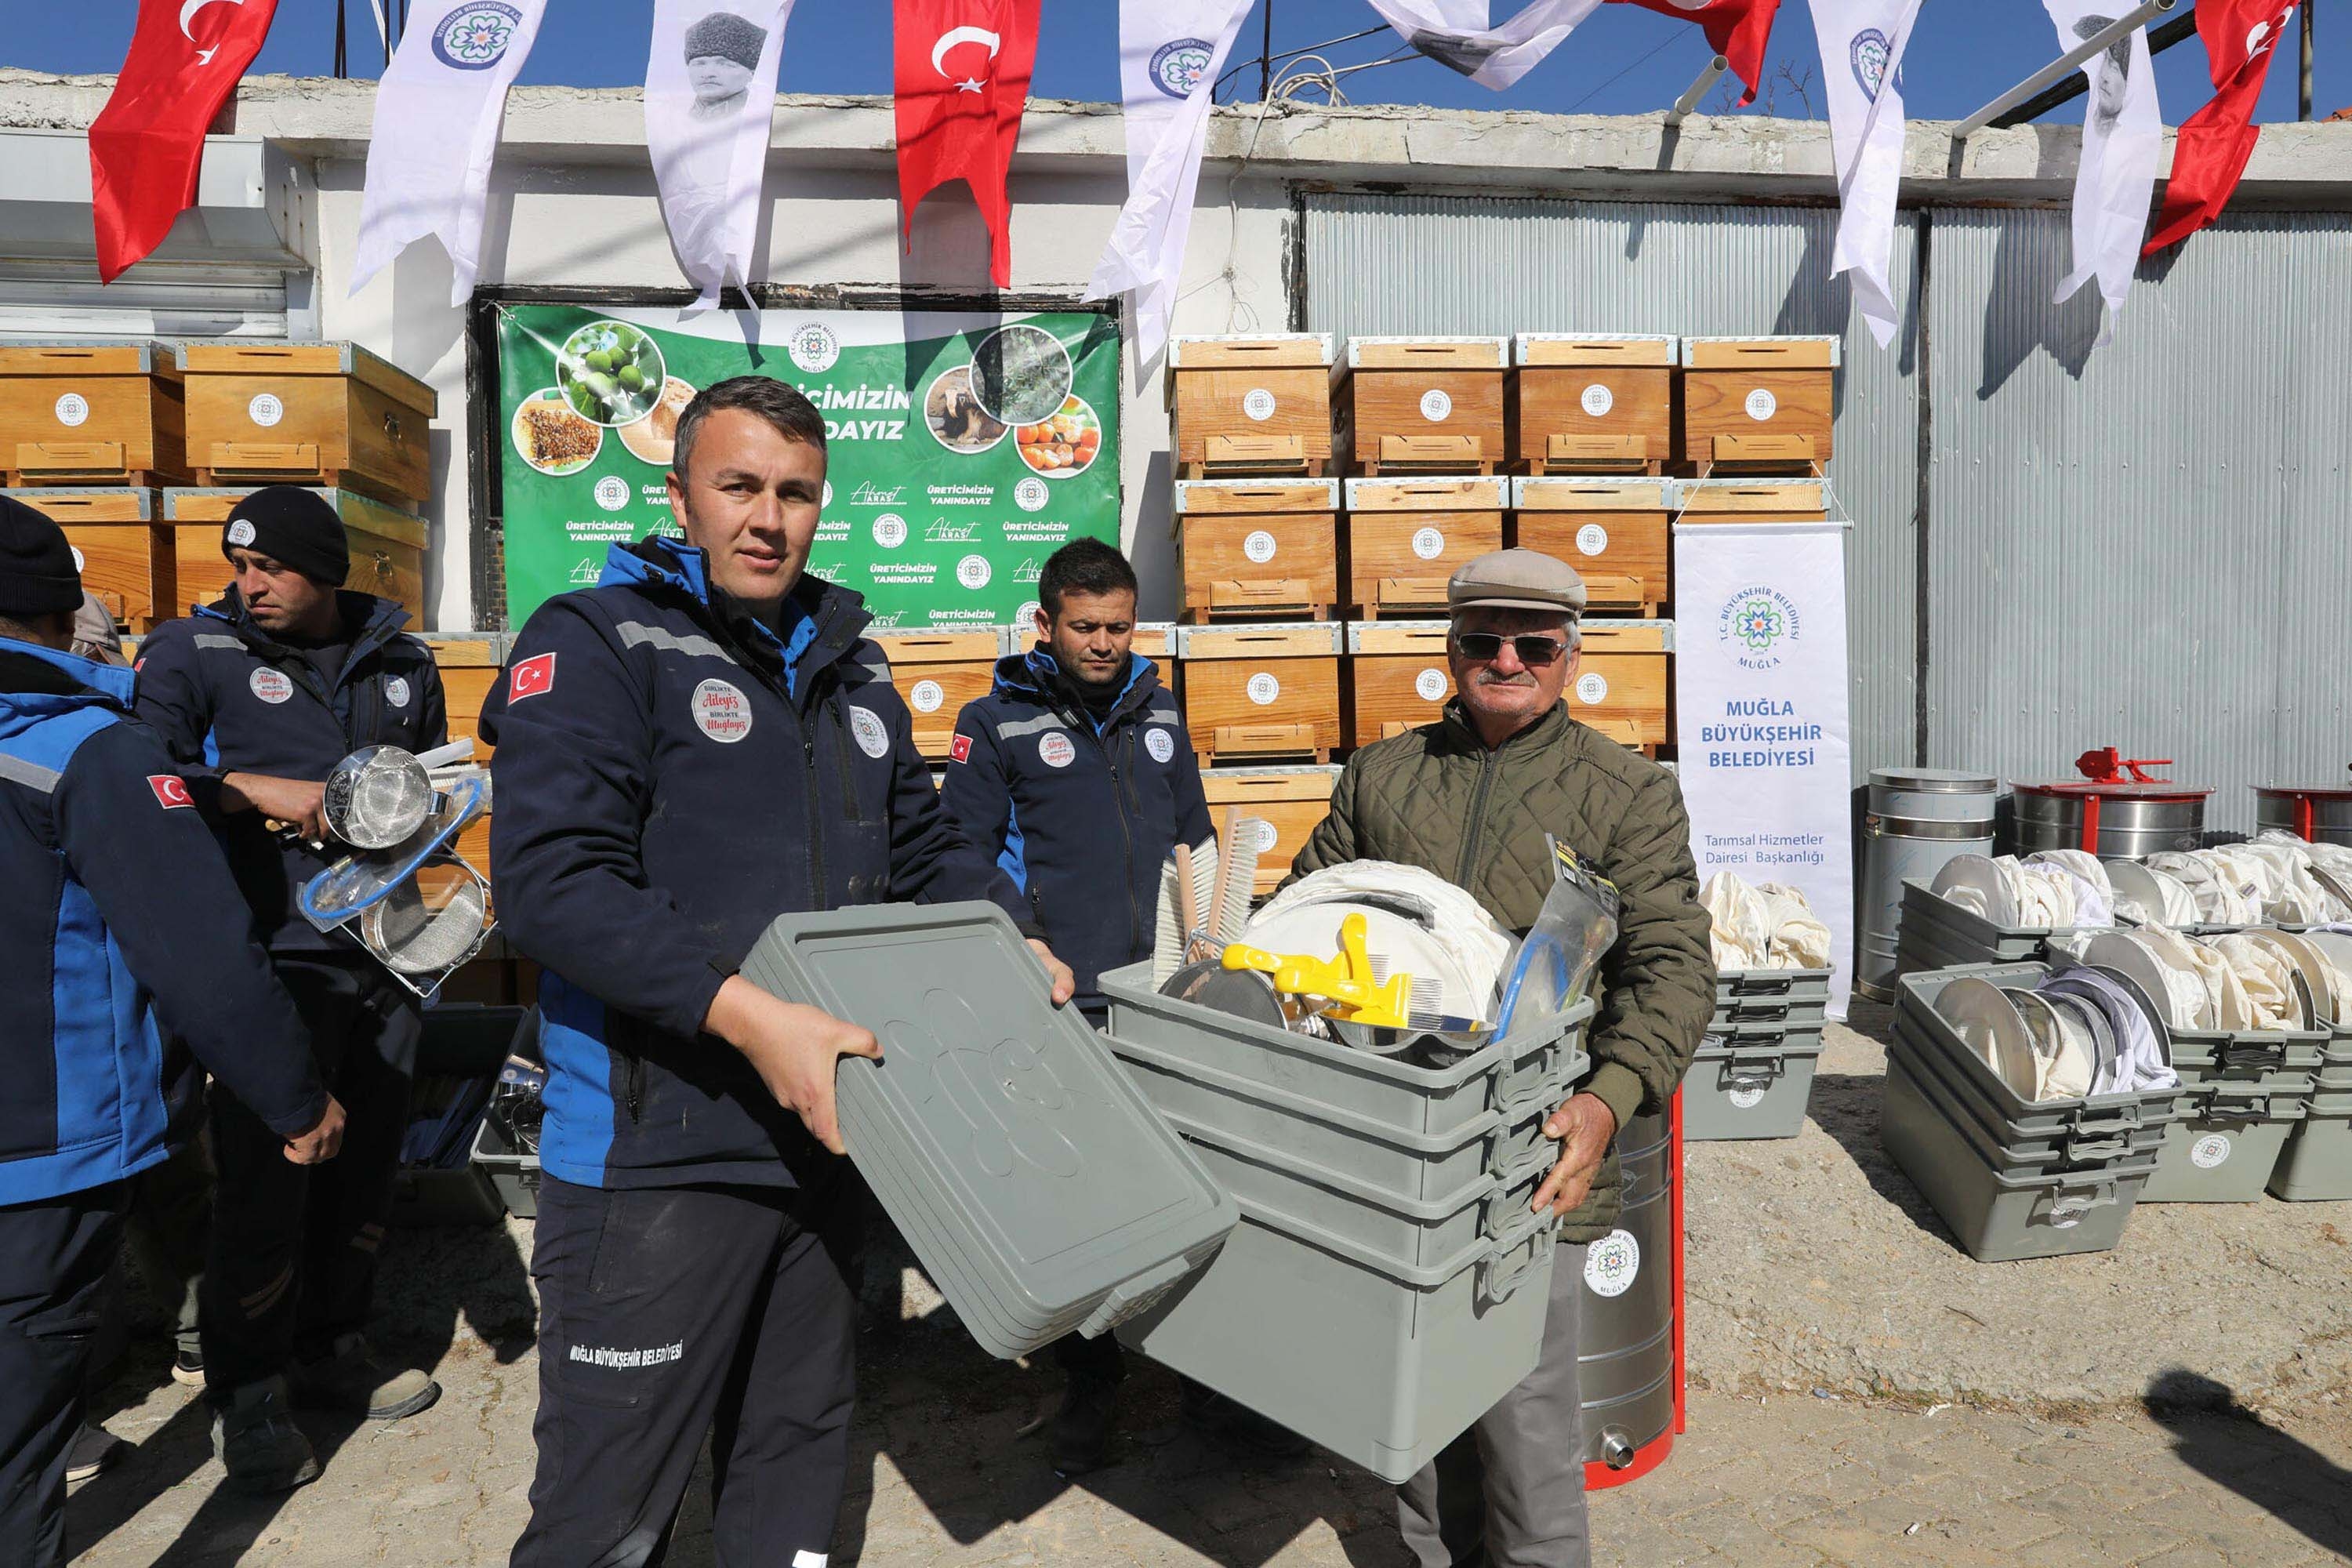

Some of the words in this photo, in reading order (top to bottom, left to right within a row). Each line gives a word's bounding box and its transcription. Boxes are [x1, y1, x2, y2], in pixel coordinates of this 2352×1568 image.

[797, 383, 910, 409] CİMİZİN
[826, 420, 905, 440] DAYIZ
[927, 484, 994, 495] ÜRETİCİMİZİN
[565, 520, 634, 531] ÜRETİCİMİZİN
[1003, 521, 1069, 531] ÜRETİCİMİZİN
[869, 562, 937, 573] ÜRETİCİMİZİN
[873, 575, 935, 584] YANINDAYIZ
[929, 609, 996, 619] ÜRETİCİMİZİN
[1721, 586, 1772, 620] BÜYÜKŞEHİR
[1773, 592, 1800, 640] BELEDİYESİ
[1738, 657, 1780, 670] MUĞLA
[702, 692, 739, 710] Aileyiz
[1726, 698, 1795, 716] MUĞLA
[1701, 722, 1822, 745] BÜYÜKŞEHİR
[1709, 747, 1814, 767] BELEDİYESİ
[1705, 834, 1755, 847] Tarımsal
[1759, 833, 1824, 846] Hizmetler
[1706, 851, 1748, 863] Dairesi
[1755, 851, 1824, 865] Başkanlığı
[570, 1345, 593, 1363] MUĞLA
[594, 1346, 641, 1371] BÜYÜKŞEHİR
[641, 1339, 684, 1367] BELEDİYESİ
